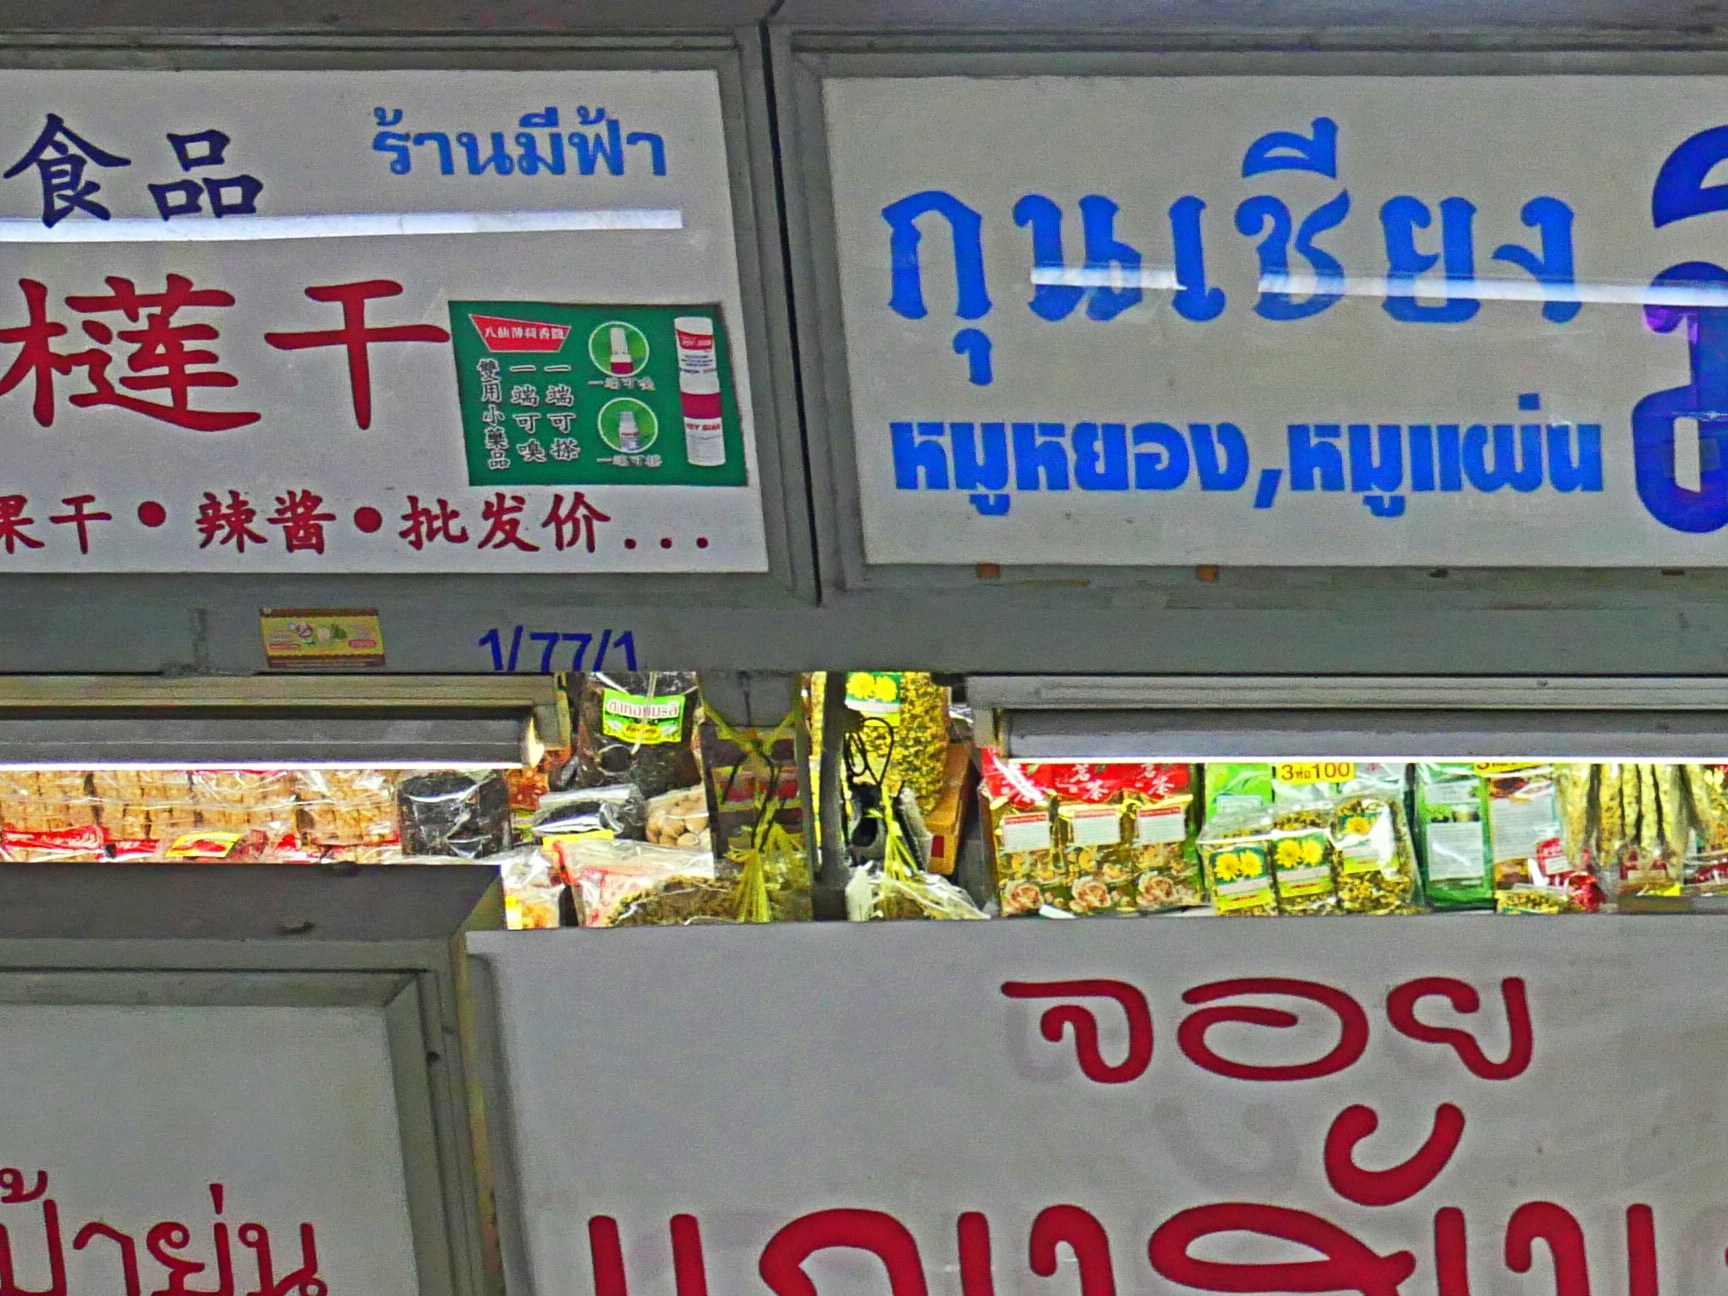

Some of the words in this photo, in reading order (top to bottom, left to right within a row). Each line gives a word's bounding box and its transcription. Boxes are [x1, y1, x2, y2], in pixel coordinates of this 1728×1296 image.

[2, 113, 265, 229] 食品
[371, 106, 667, 178] ร้านมีฟ้า
[881, 115, 1578, 387] กุนเชียง
[889, 392, 1605, 520] หมูหยอง,หมูแผ่น
[477, 629, 638, 672] 1/77/1
[1000, 973, 1536, 1086] จอย
